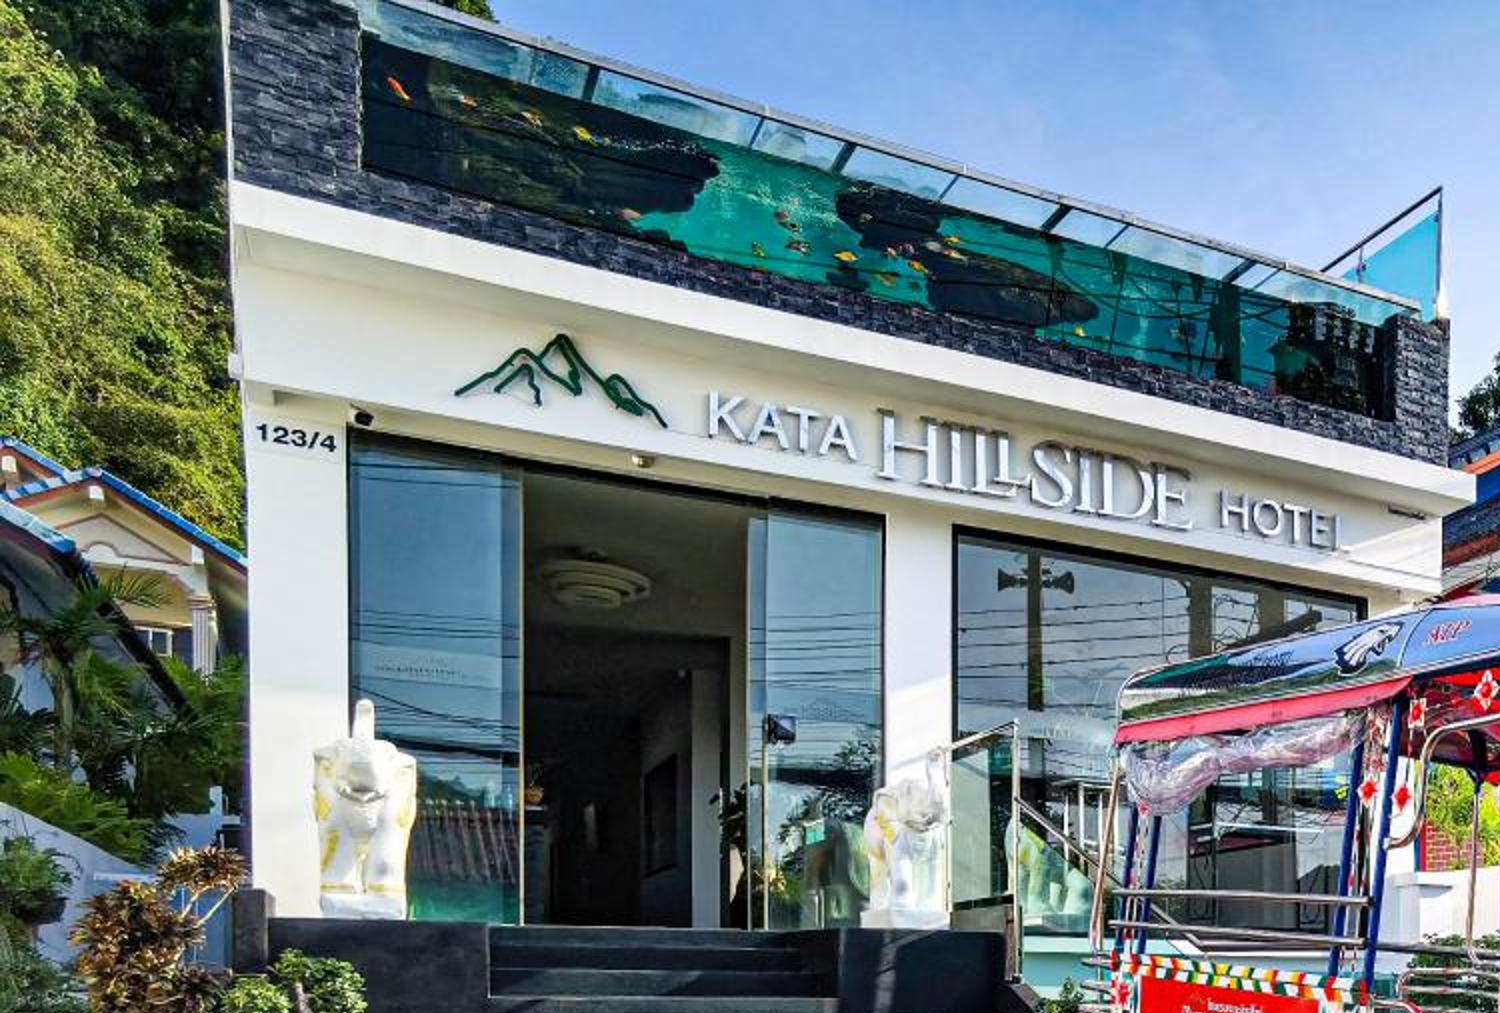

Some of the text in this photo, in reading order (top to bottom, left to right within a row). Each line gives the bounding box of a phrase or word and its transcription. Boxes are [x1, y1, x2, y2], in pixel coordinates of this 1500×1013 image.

[255, 424, 338, 453] 123/4
[708, 390, 1350, 554] KATA HILLSIDE HOTEL
